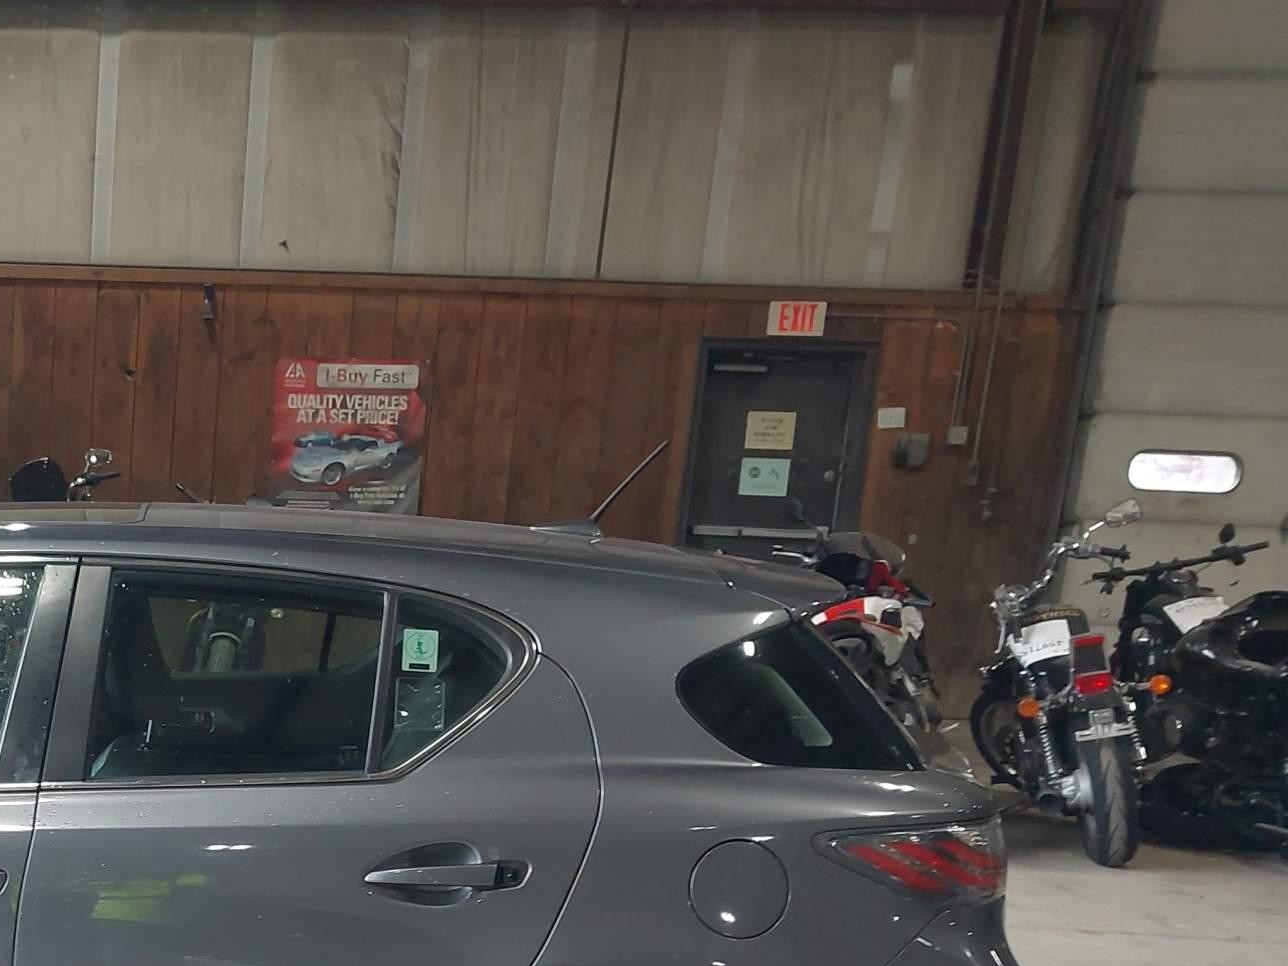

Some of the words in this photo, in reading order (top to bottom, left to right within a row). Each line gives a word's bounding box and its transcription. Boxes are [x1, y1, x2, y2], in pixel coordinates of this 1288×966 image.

[778, 303, 818, 332] EXIT
[325, 368, 369, 385] I-Buy
[373, 368, 406, 384] Fast
[287, 393, 344, 409] QUALITY
[346, 394, 408, 411] VEHICLES
[296, 409, 316, 424] AT
[316, 409, 327, 424] A
[329, 409, 355, 425] SET
[356, 410, 400, 425] PRICE!
